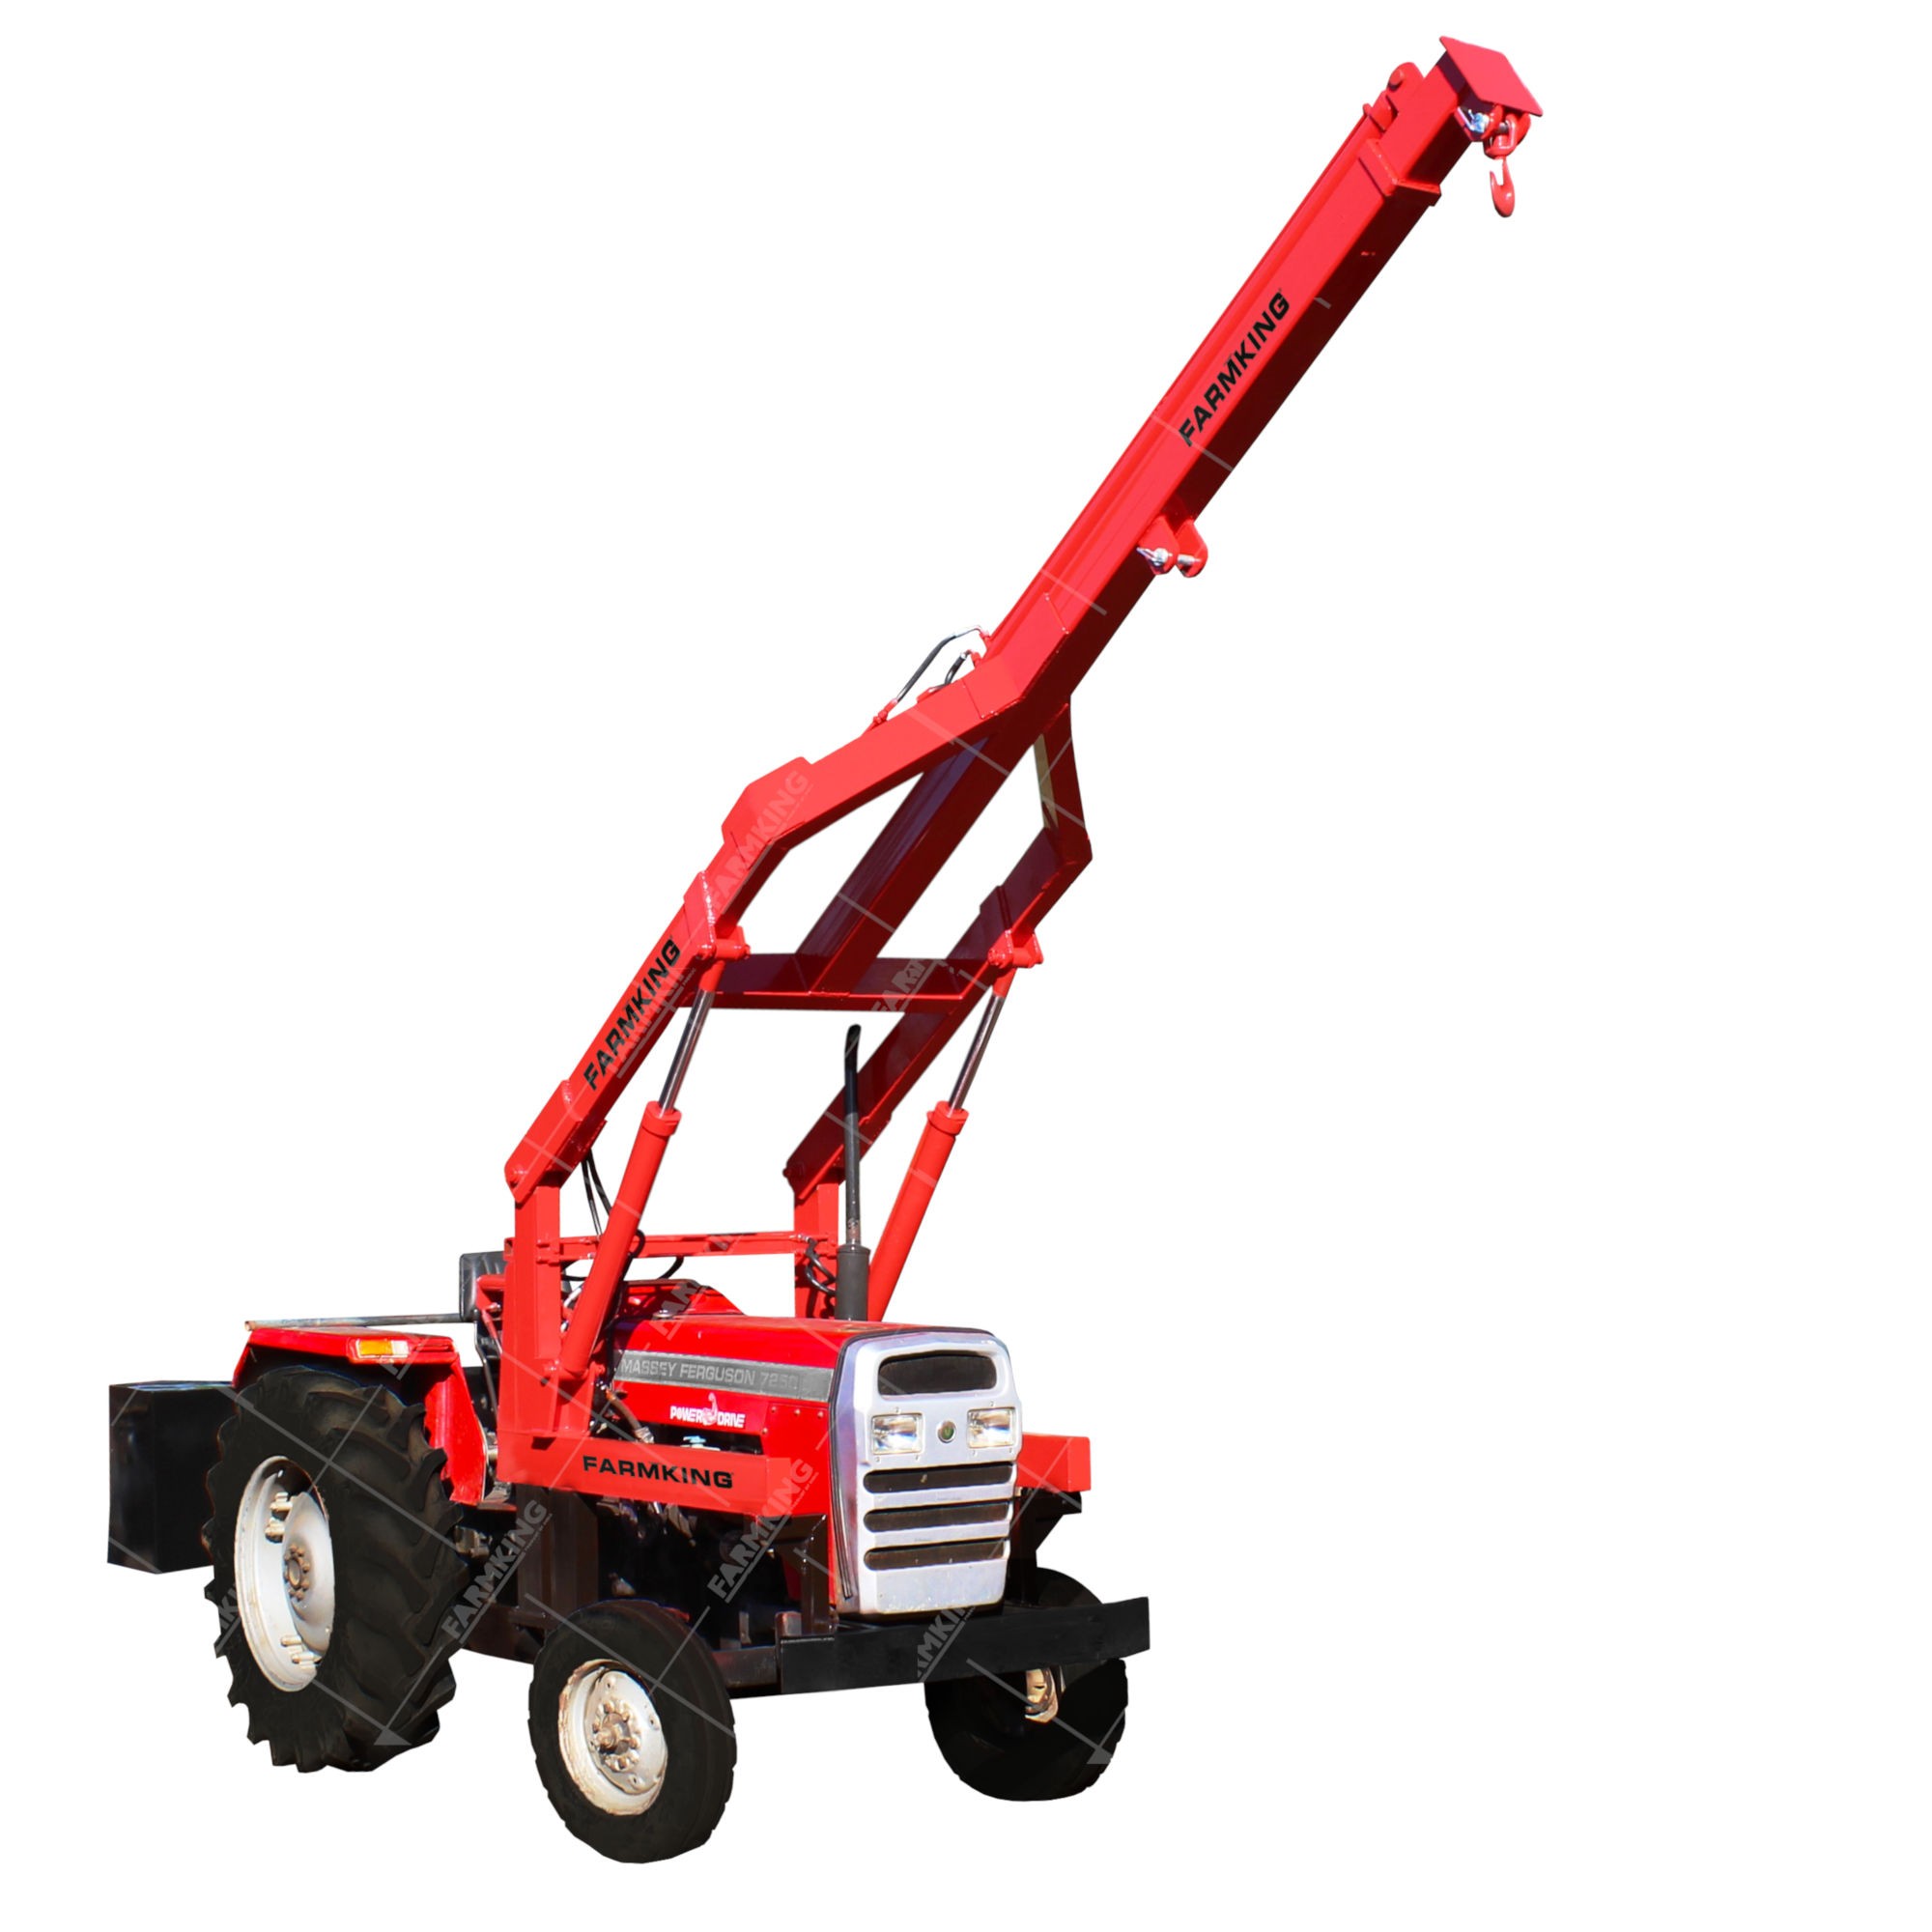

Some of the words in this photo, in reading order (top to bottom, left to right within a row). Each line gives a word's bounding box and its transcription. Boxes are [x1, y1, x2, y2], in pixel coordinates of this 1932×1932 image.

[1179, 291, 1290, 447] FARMKING
[583, 938, 681, 1091] FARMKING
[620, 1358, 677, 1378] MASSEY
[679, 1363, 755, 1385] FERGUSON
[669, 1406, 704, 1424] POWER
[717, 1412, 746, 1429] DRIVE
[582, 1456, 733, 1489] FARMKING
